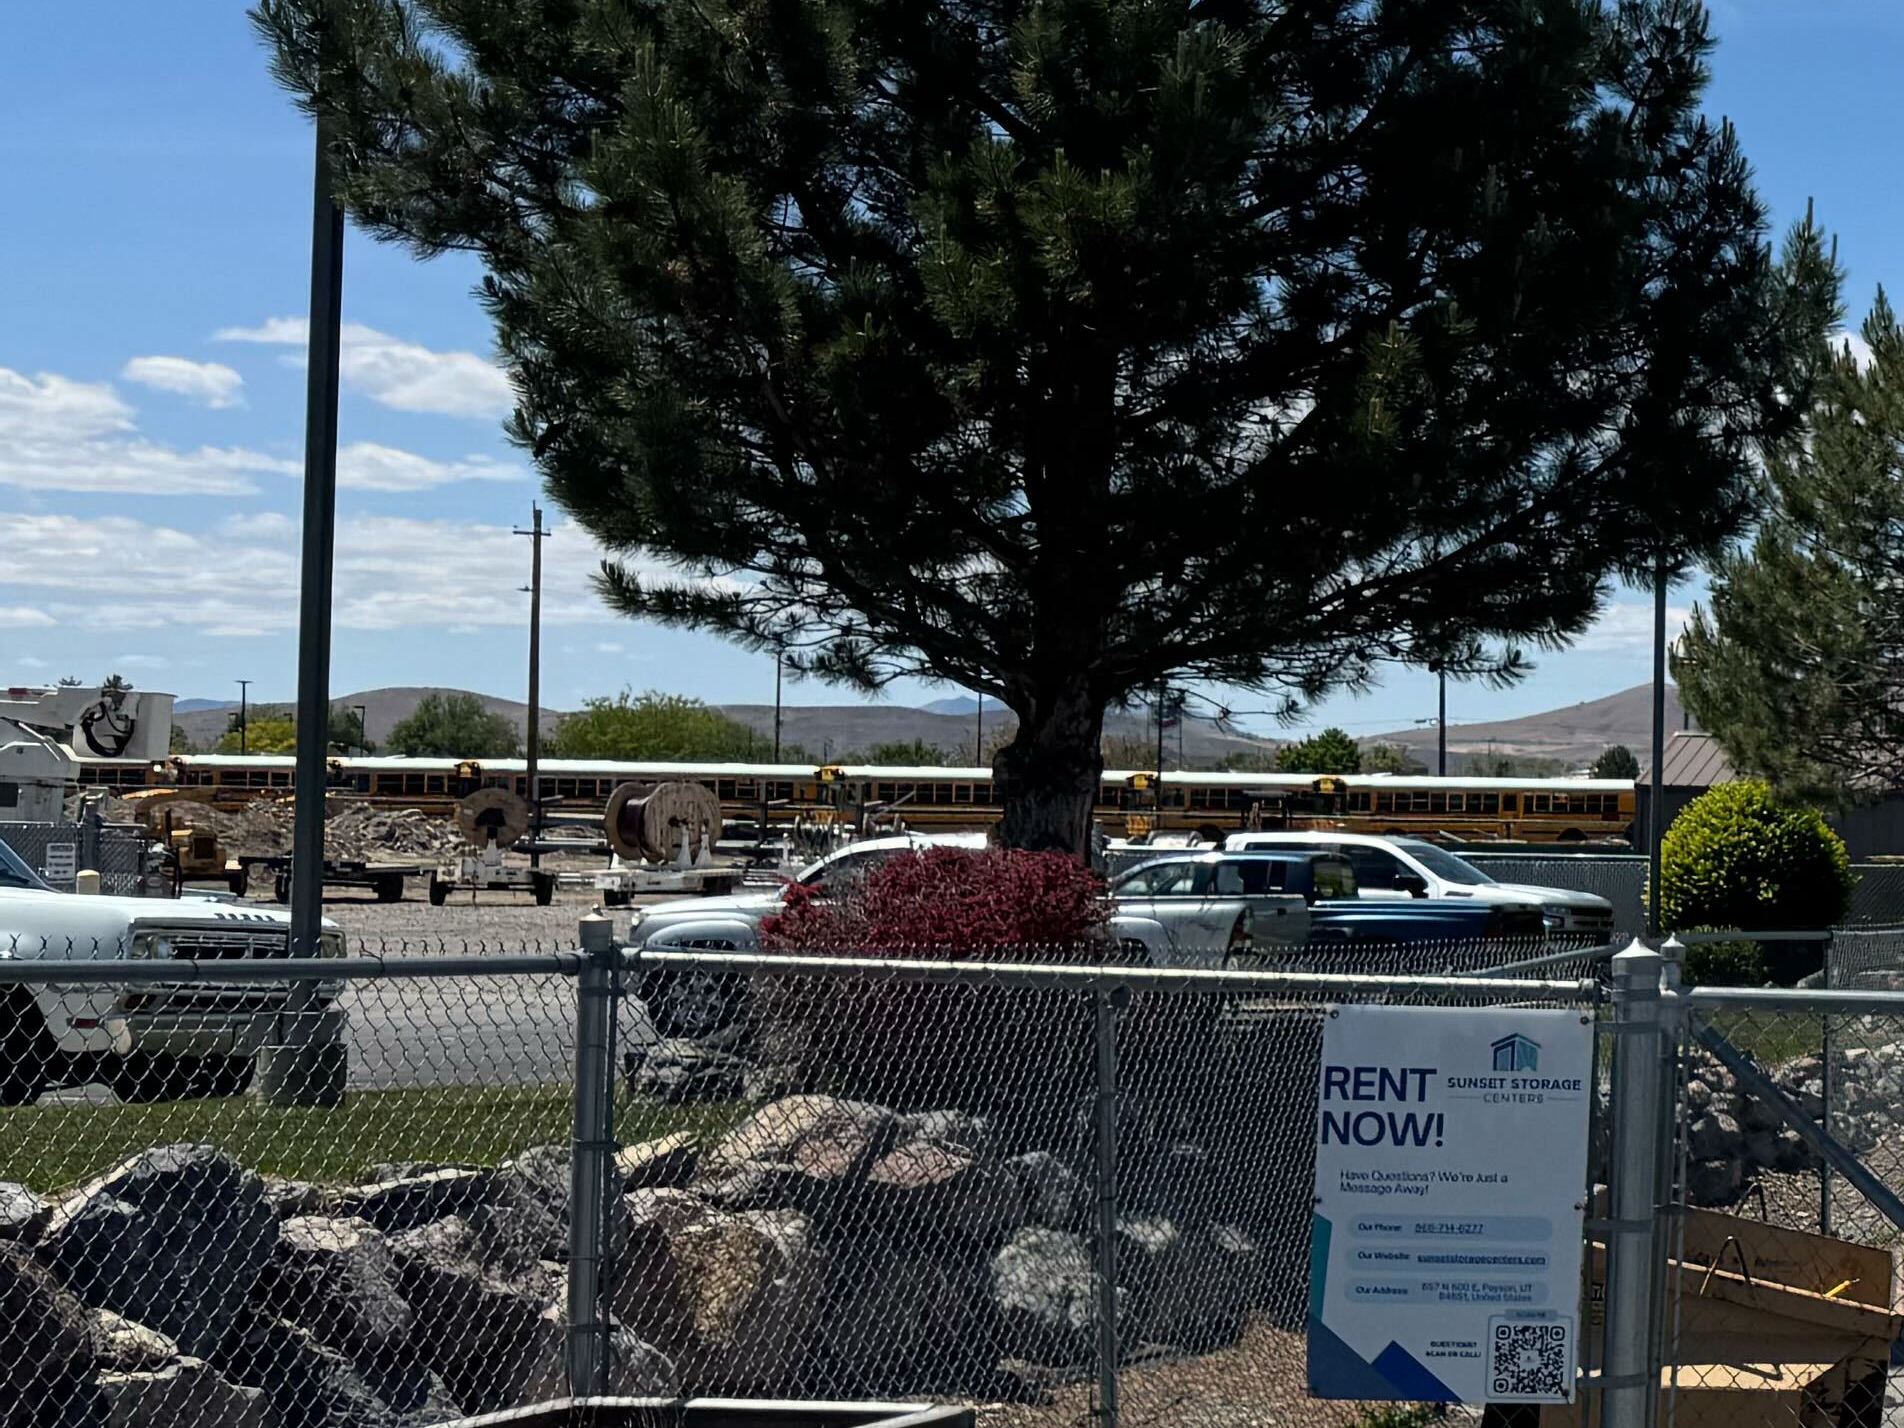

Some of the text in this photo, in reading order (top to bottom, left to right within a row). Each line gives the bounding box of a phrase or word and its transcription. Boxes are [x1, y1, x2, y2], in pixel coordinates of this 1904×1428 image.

[1323, 1065, 1438, 1102] RENT
[1447, 1077, 1583, 1091] SUNSET STORAGE
[1482, 1092, 1545, 1104] CENTERS
[1321, 1110, 1445, 1148] NOW!
[1340, 1169, 1369, 1182] Have
[1371, 1169, 1437, 1183] Questions?
[1438, 1170, 1474, 1183] We're
[1500, 1174, 1508, 1183] a
[1340, 1182, 1430, 1196] Message Away!
